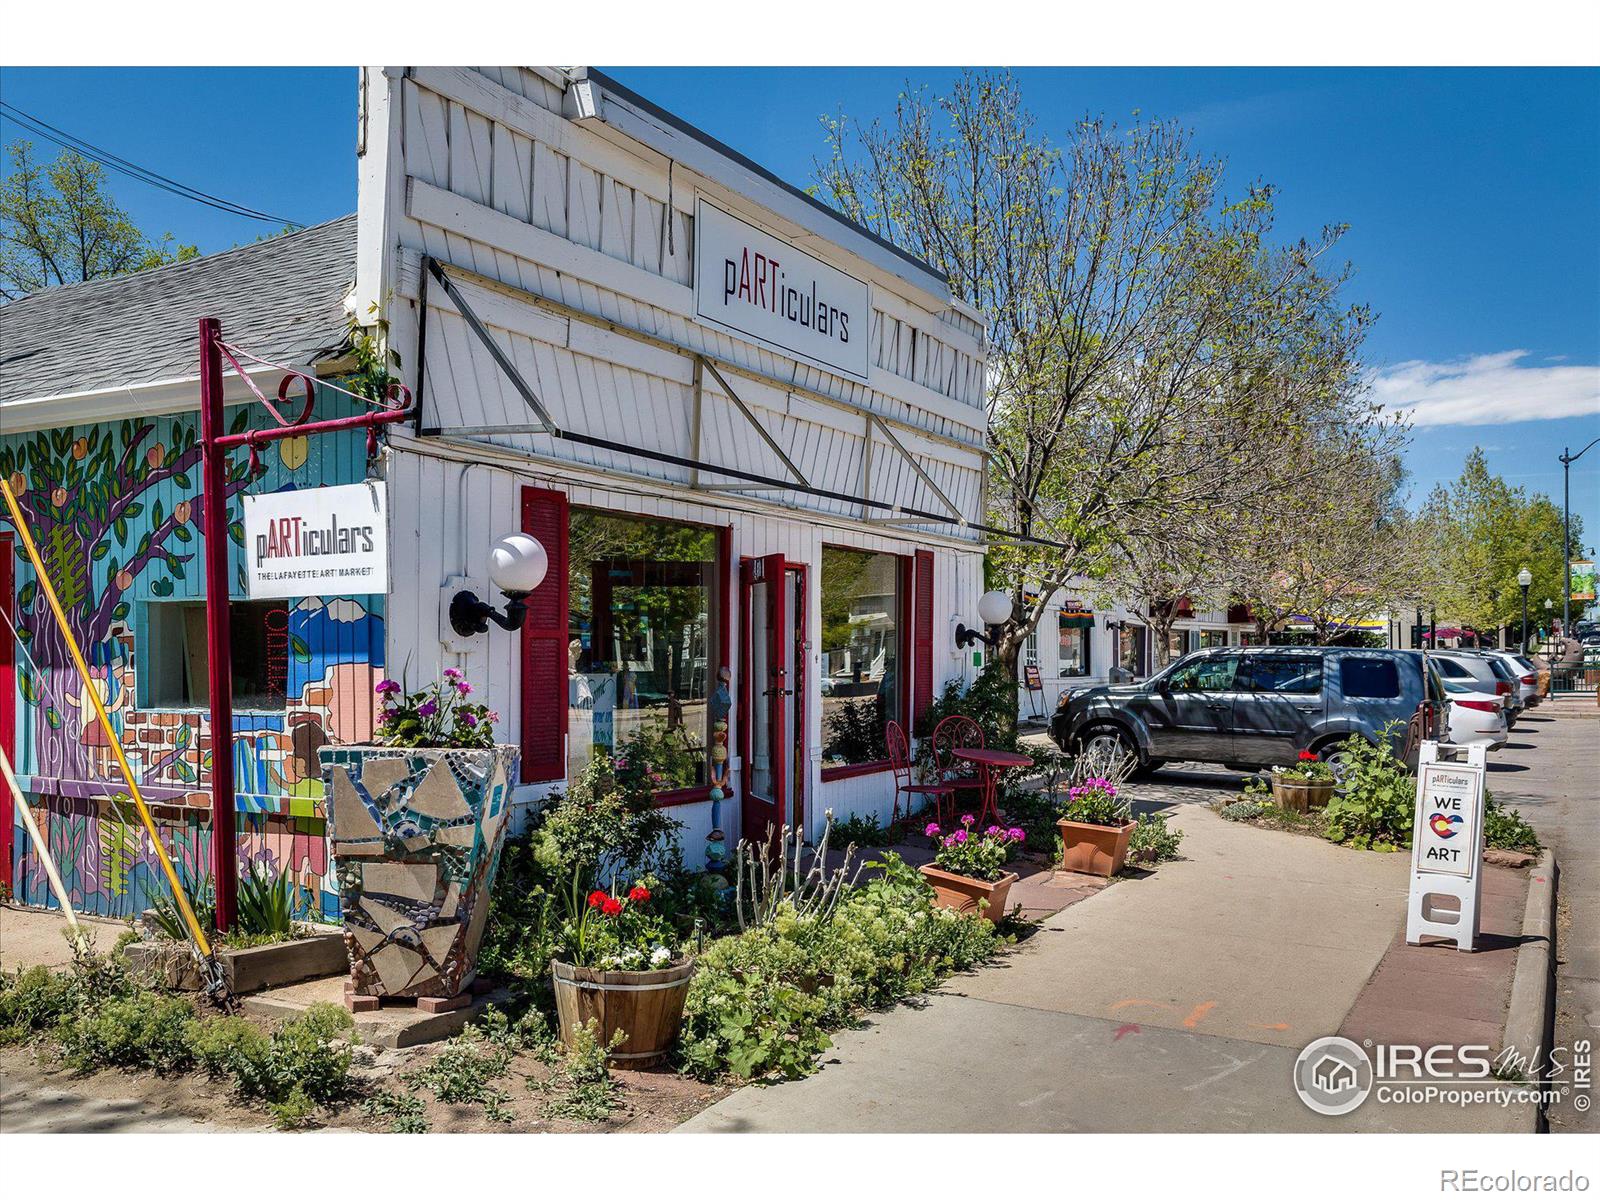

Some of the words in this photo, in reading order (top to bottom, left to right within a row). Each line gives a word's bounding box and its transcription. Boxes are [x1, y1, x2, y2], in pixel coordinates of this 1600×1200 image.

[724, 246, 849, 344] pARTiculars
[256, 513, 374, 569] pARTiculars
[257, 572, 272, 581] THE
[274, 569, 316, 580] LAFAYETTE
[320, 568, 336, 578] ART
[339, 567, 373, 577] MARKET
[1431, 774, 1469, 786] pARTiculars
[1434, 796, 1462, 810] WE
[1426, 847, 1461, 862] ART
